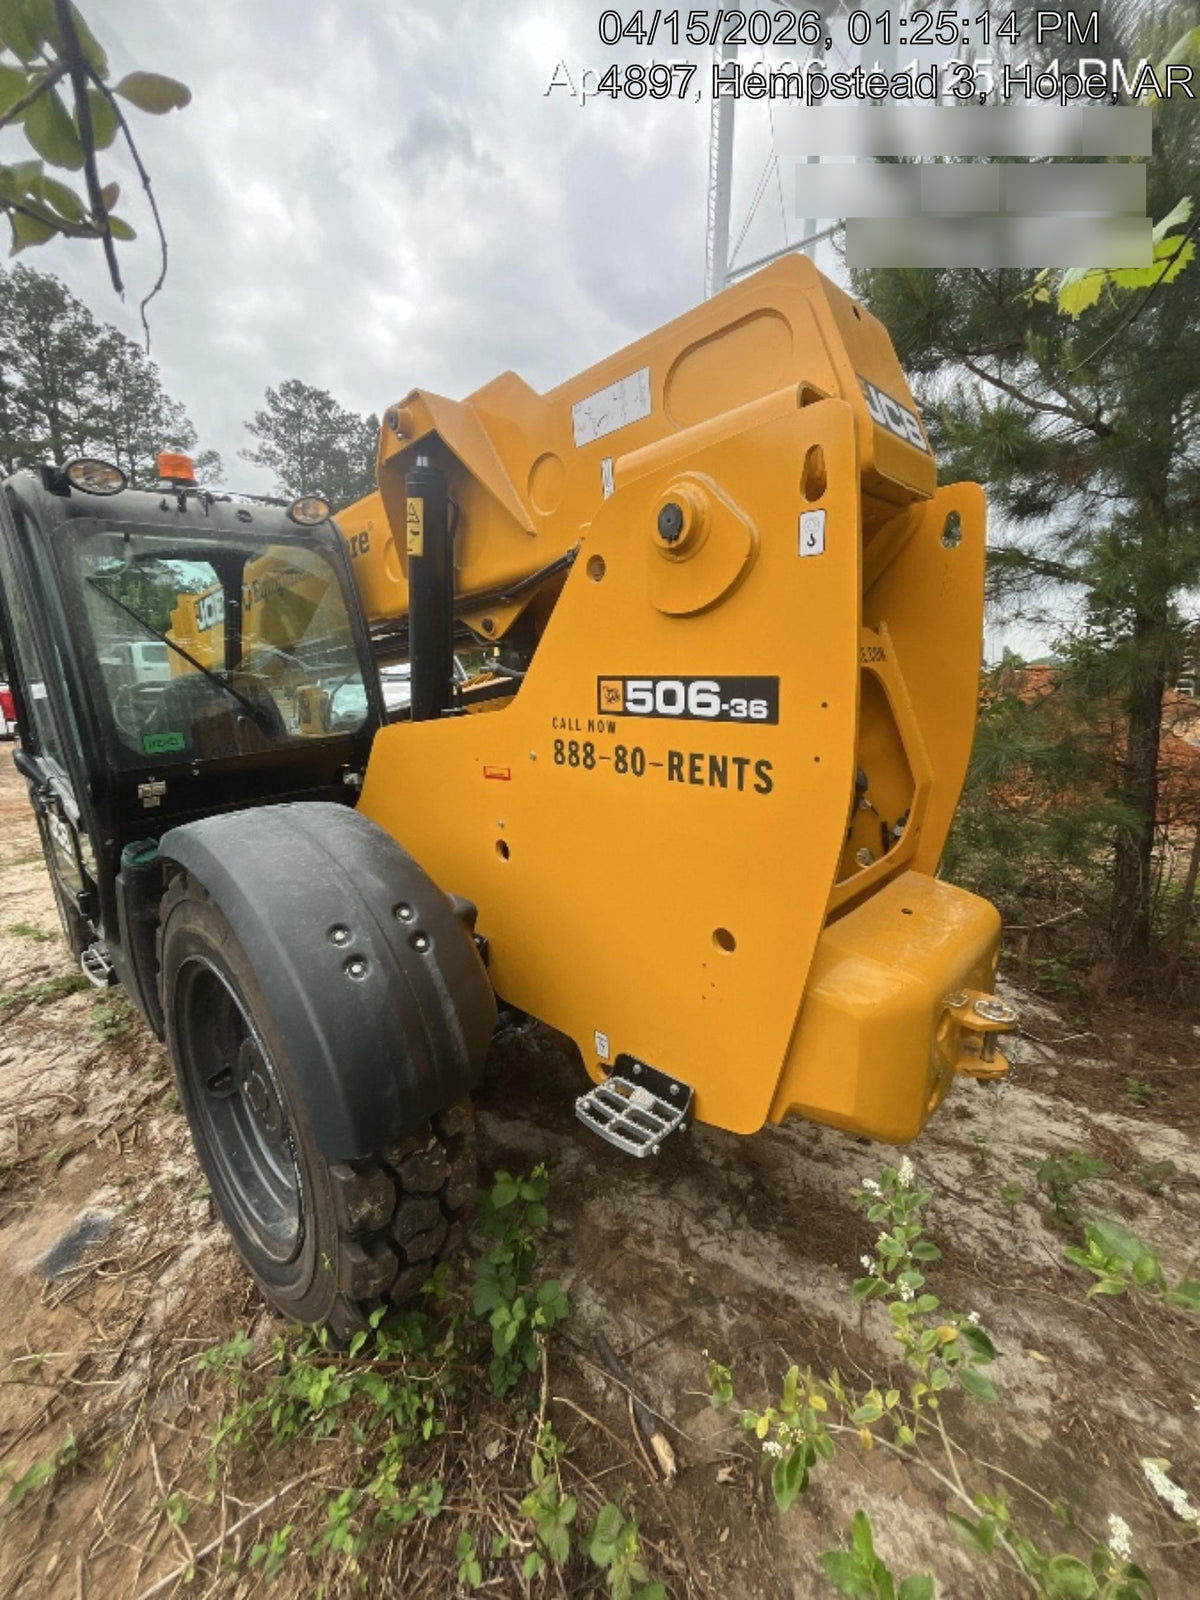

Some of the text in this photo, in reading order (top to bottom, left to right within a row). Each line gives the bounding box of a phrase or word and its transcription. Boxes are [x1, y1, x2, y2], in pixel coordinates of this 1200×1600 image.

[860, 381, 928, 451] JCB
[348, 531, 370, 559] re
[625, 679, 769, 719] 506-36
[552, 716, 617, 735] CALL NOW
[553, 738, 774, 796] 888-80-RENTS
